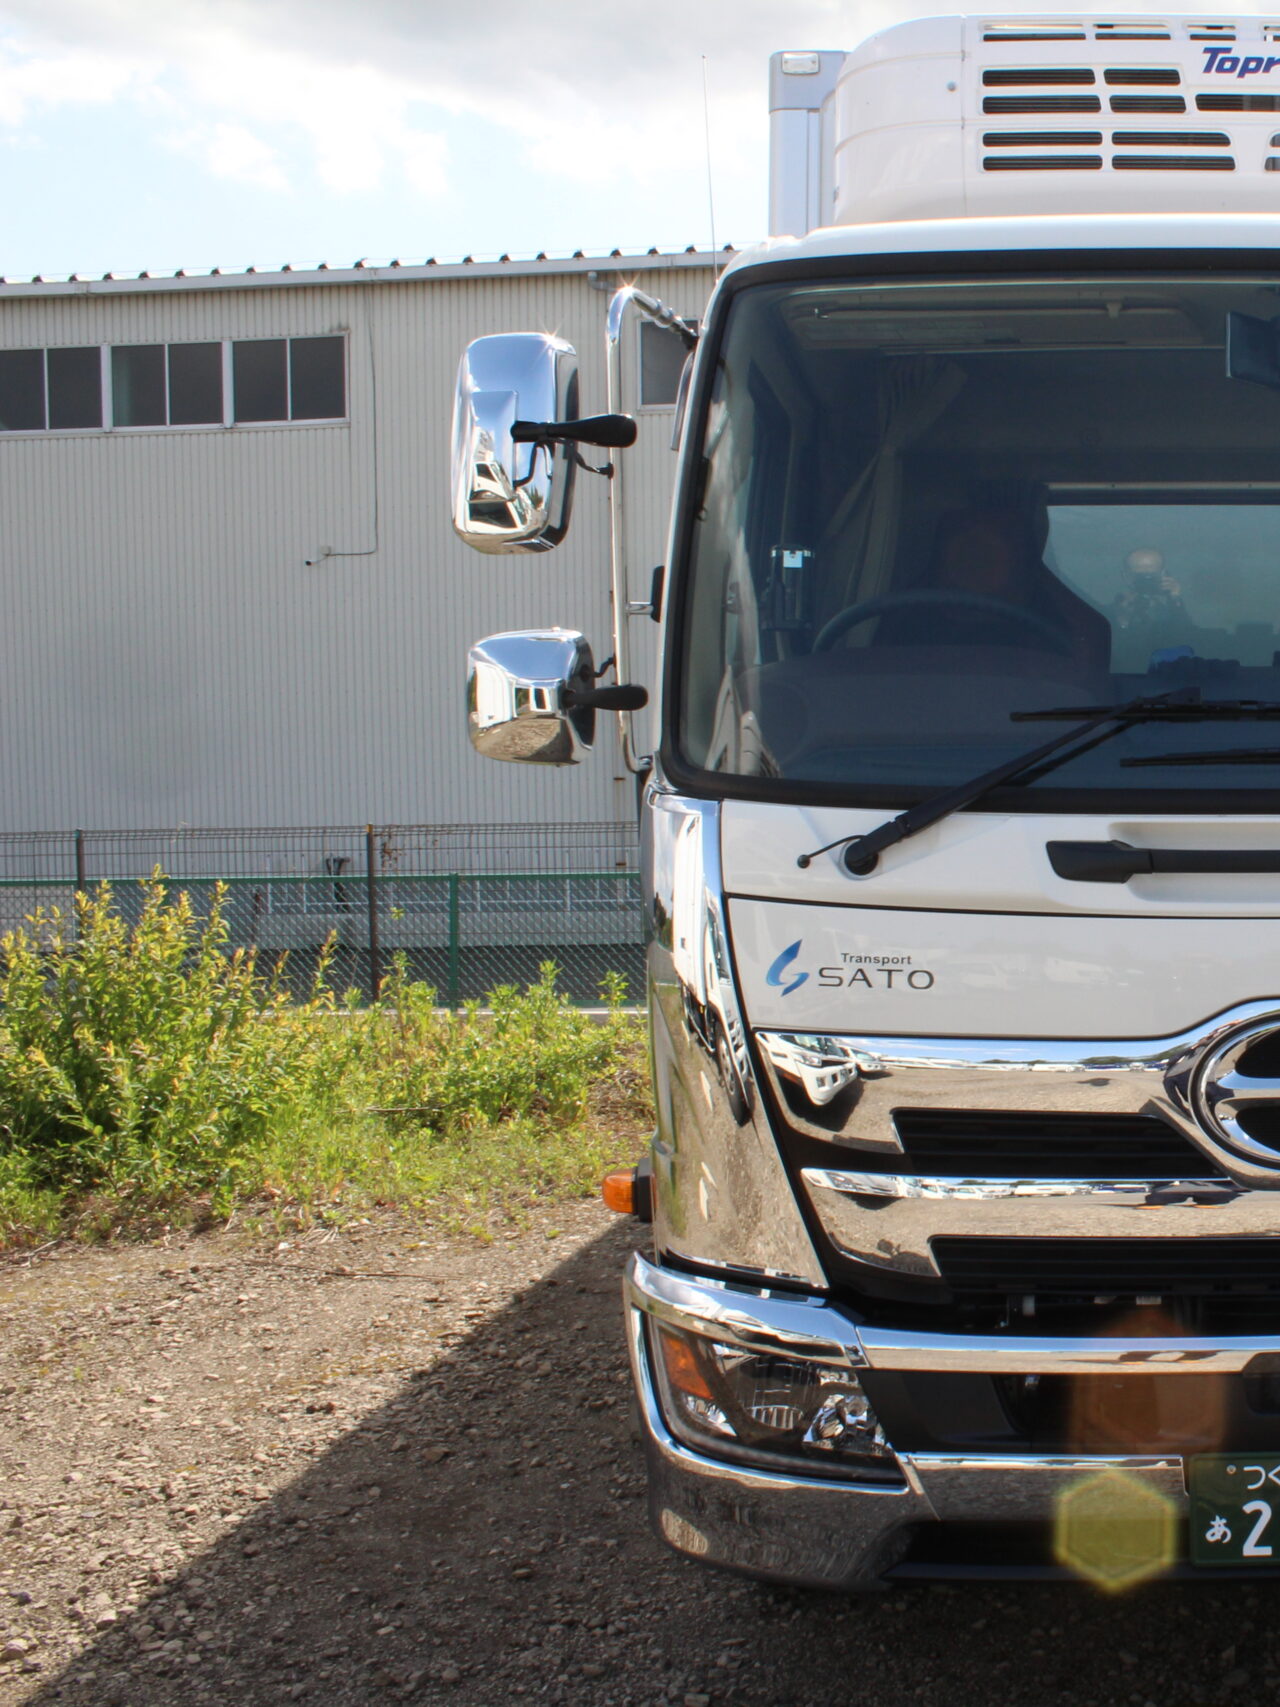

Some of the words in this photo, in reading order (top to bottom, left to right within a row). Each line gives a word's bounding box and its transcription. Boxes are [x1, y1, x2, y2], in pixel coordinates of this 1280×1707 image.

[841, 952, 912, 966] Transport
[818, 967, 935, 990] SATO
[1205, 1515, 1232, 1543] あ
